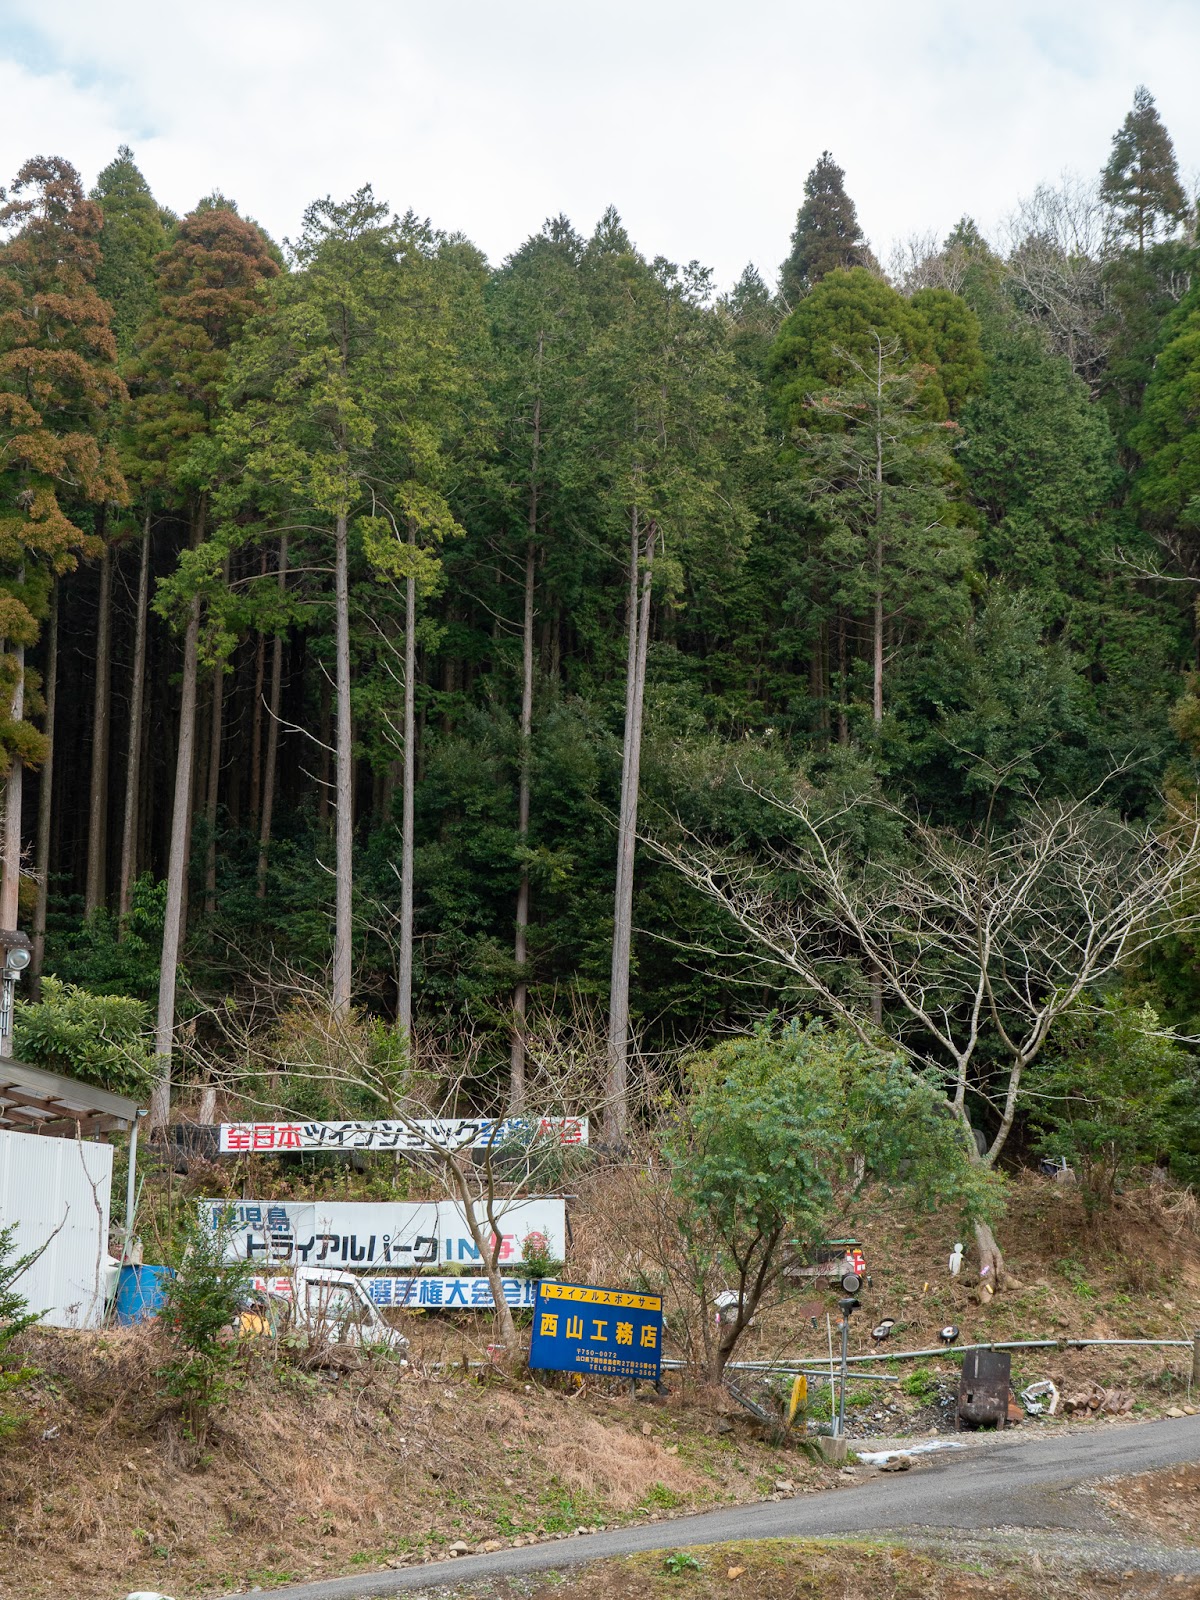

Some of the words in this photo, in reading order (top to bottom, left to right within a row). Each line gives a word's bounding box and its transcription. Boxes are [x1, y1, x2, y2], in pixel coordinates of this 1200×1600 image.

[545, 1286, 656, 1307] トライアルスポンサー
[540, 1313, 657, 1348] 西山工務店
